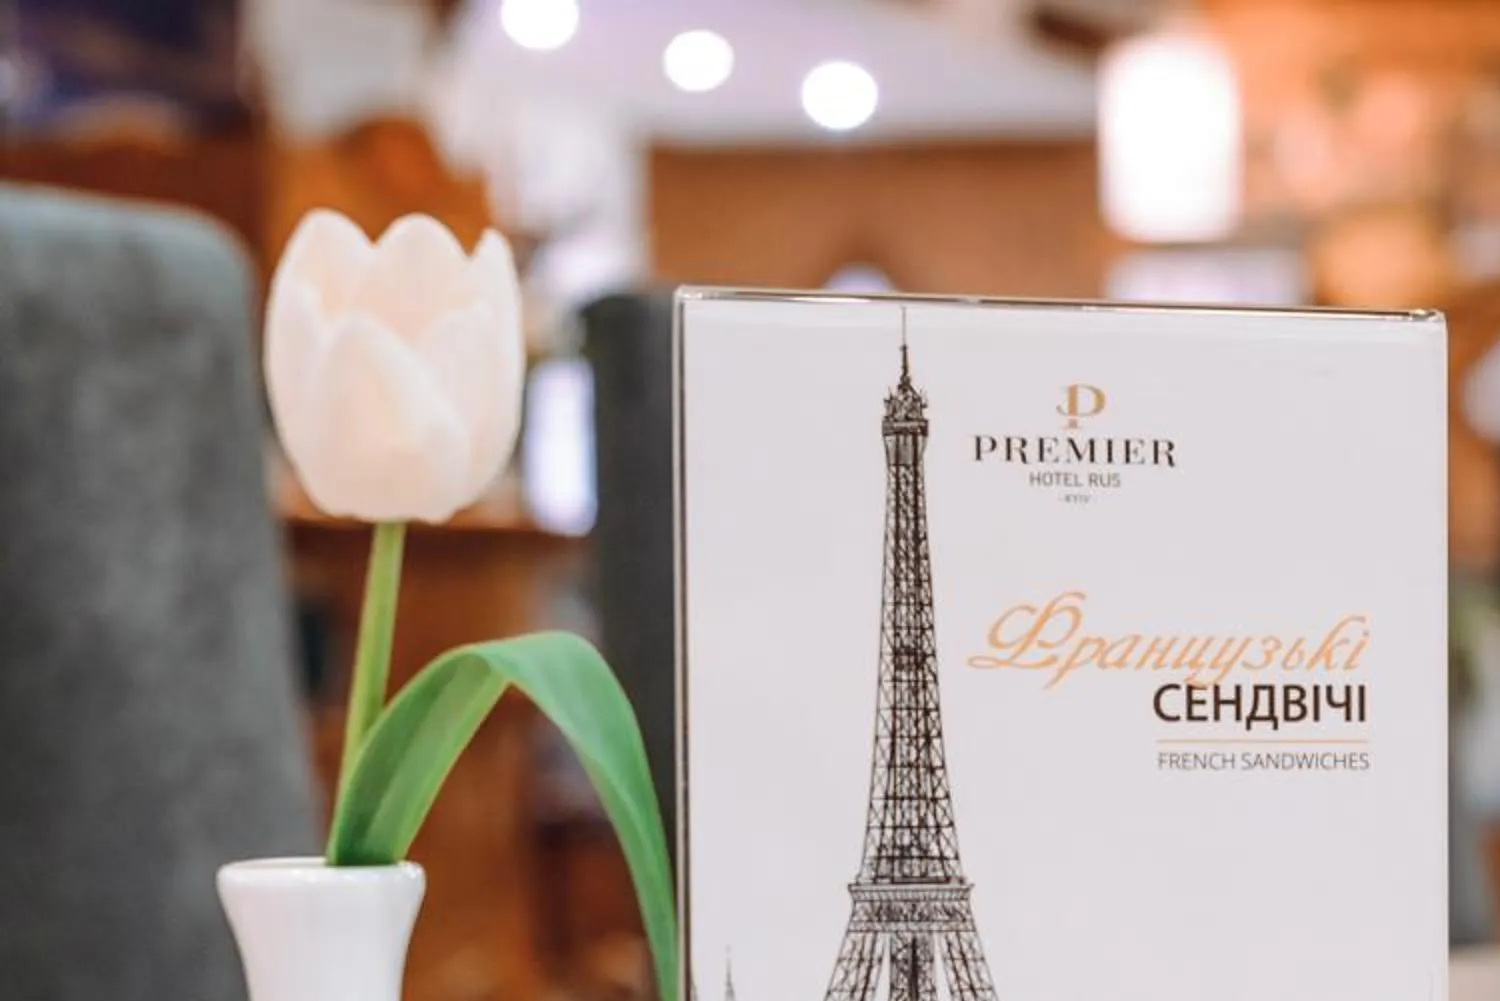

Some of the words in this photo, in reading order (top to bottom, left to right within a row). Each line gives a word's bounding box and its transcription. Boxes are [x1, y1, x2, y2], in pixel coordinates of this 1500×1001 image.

[973, 434, 1178, 468] PREMIER
[1029, 472, 1083, 488] HOTEL
[1088, 472, 1121, 488] RUS
[967, 591, 1371, 690] Французькі
[1153, 682, 1367, 731] СЕНДВІЧІ
[1157, 751, 1235, 770] FRENCH
[1241, 751, 1370, 771] SANDWICHES
